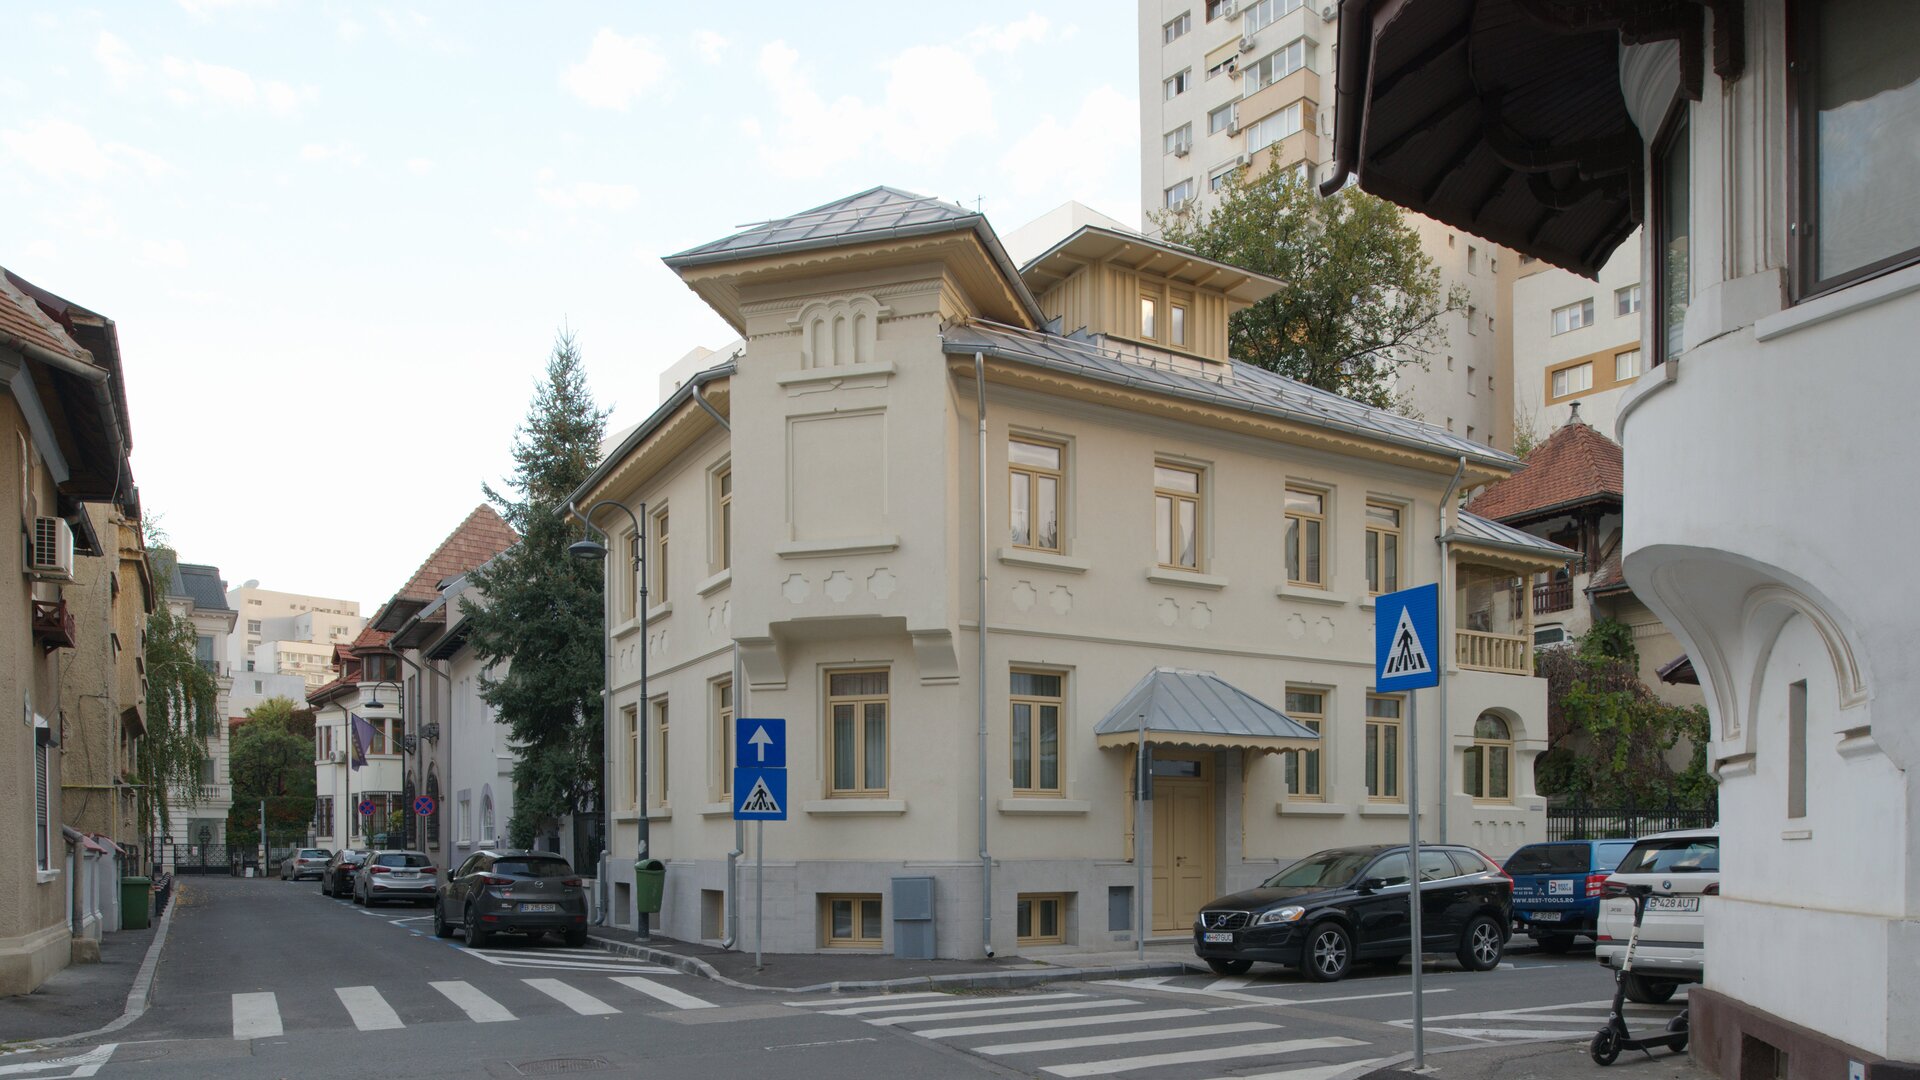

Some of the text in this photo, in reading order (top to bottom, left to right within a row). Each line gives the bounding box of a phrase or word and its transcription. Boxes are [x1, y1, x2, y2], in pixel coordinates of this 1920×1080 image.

[1650, 898, 1696, 908] B 428 AUT
